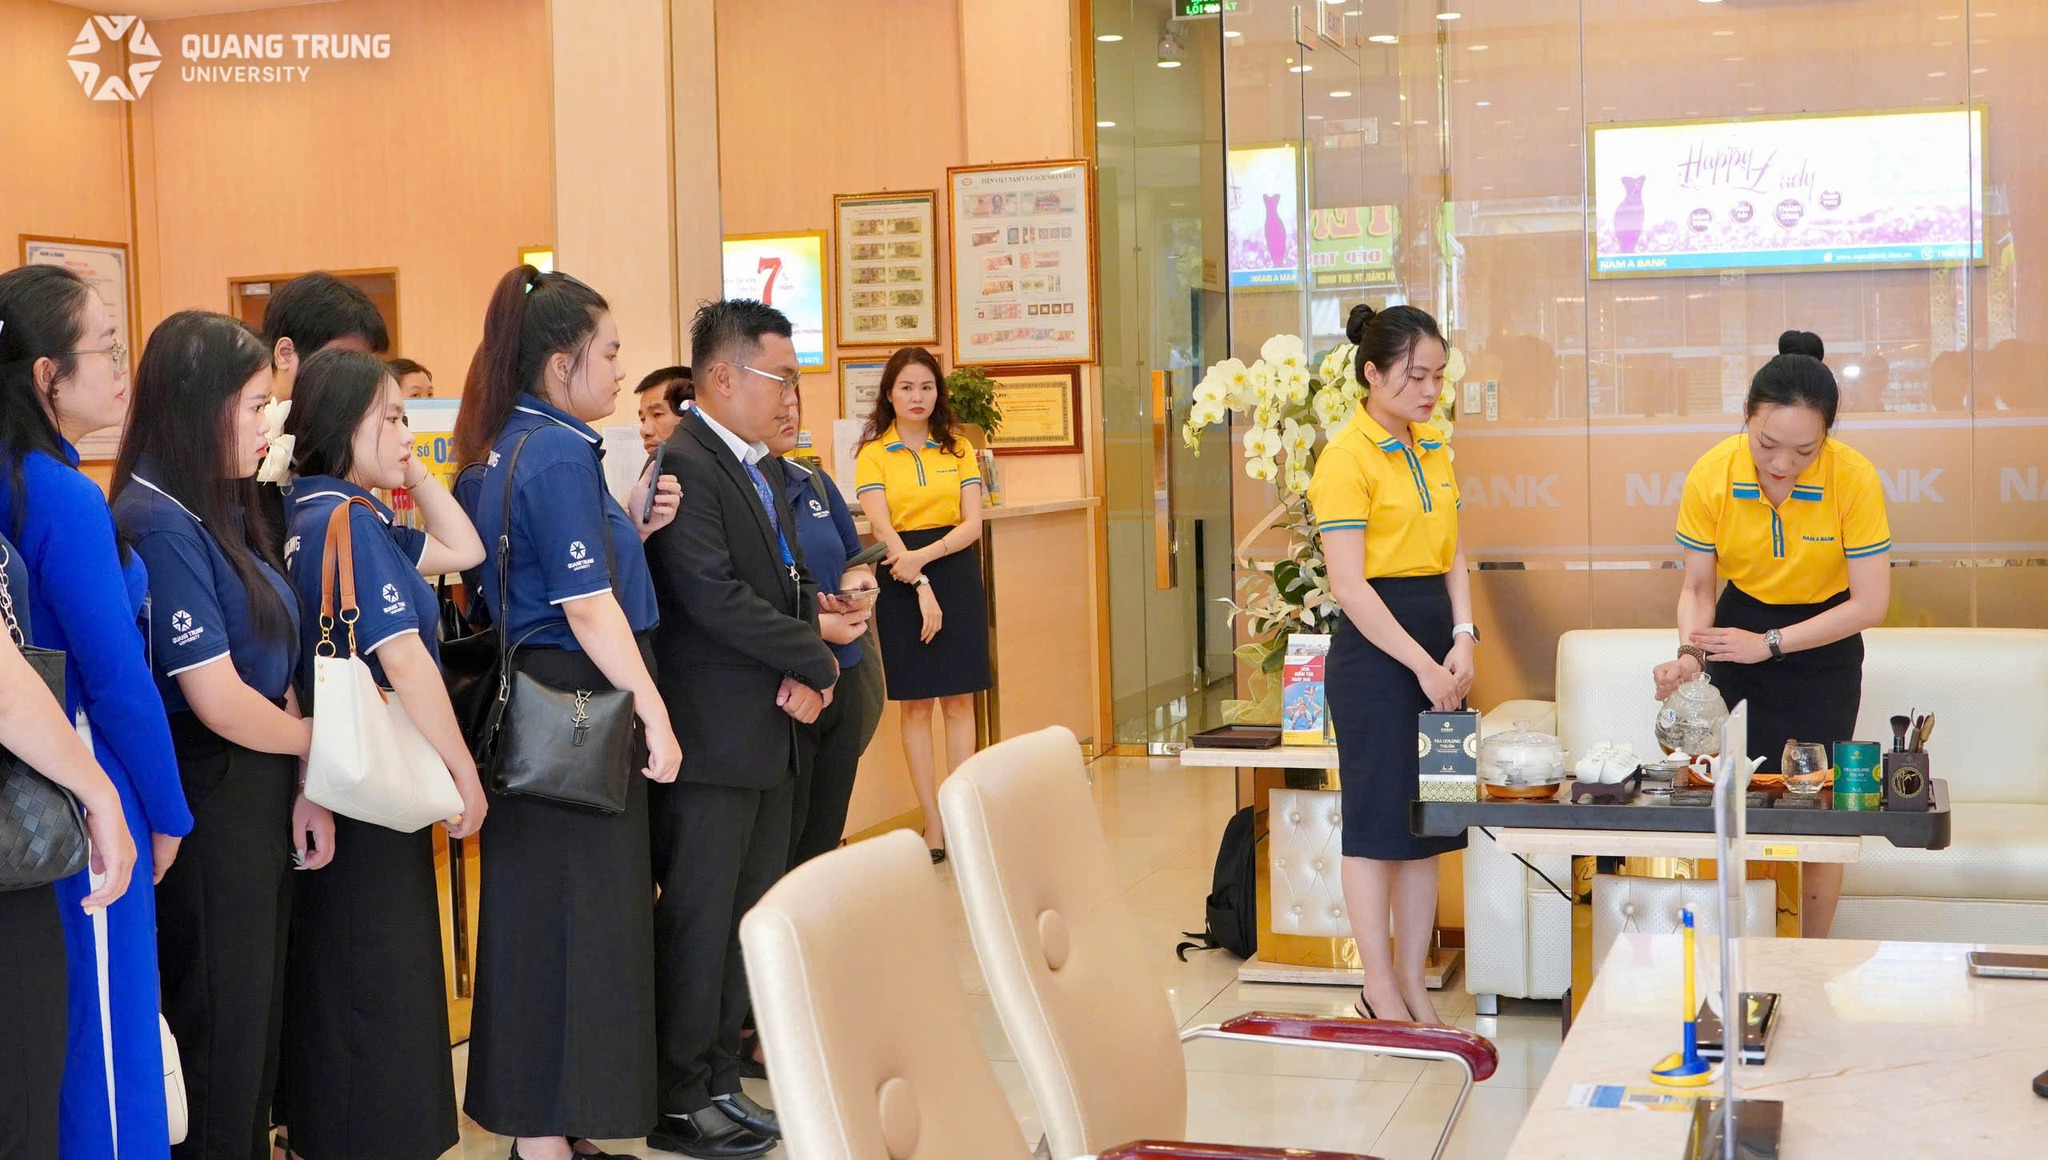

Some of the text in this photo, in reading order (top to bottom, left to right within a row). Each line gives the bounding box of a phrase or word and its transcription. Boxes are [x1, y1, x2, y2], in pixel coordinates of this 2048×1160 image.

[1627, 260, 1635, 268] A
[1636, 258, 1667, 268] BANK
[1461, 473, 1563, 509] ANK
[1624, 472, 1687, 507] NA
